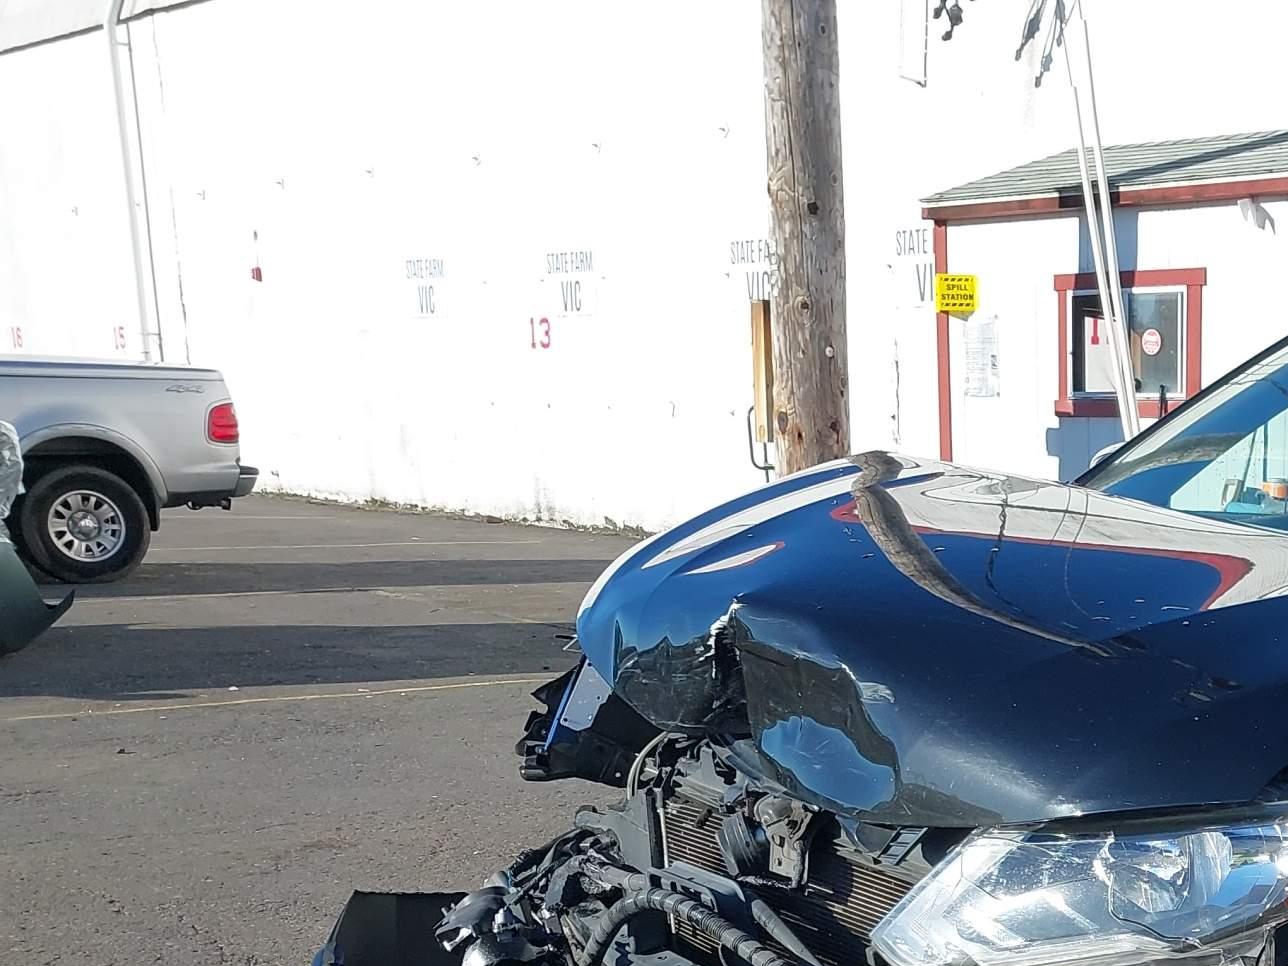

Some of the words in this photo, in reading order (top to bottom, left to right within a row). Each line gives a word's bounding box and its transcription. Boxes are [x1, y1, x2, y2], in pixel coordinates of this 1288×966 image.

[730, 239, 756, 265] STATE
[758, 239, 770, 264] FA
[895, 228, 928, 257] STATE
[405, 258, 424, 279] STATE
[425, 258, 445, 279] FARM
[546, 251, 569, 275] STATE
[570, 250, 593, 273] FARM
[745, 270, 770, 301] VIC
[915, 262, 934, 302] VI
[945, 283, 969, 291] SPILL
[417, 285, 436, 315] VIC
[560, 280, 582, 312] VIC
[941, 293, 974, 301] STATION
[112, 325, 126, 350] 15
[530, 316, 551, 350] 13
